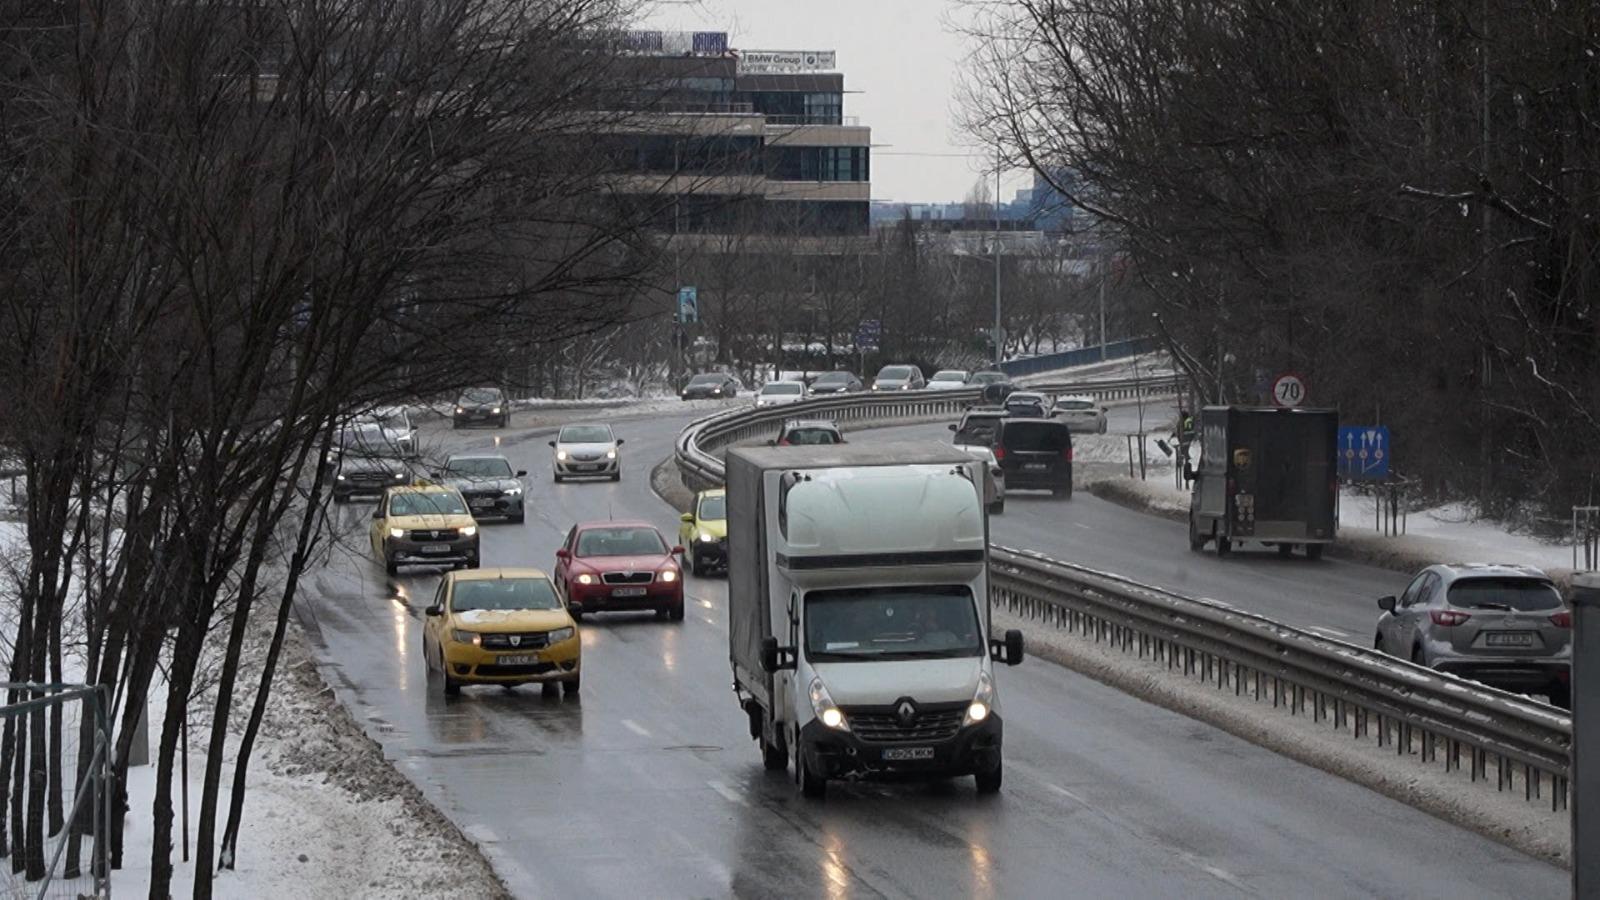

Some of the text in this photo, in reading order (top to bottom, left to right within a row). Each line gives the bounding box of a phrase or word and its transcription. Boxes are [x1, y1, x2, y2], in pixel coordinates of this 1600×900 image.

[748, 54, 801, 65] BMW Group
[1280, 382, 1300, 400] 70
